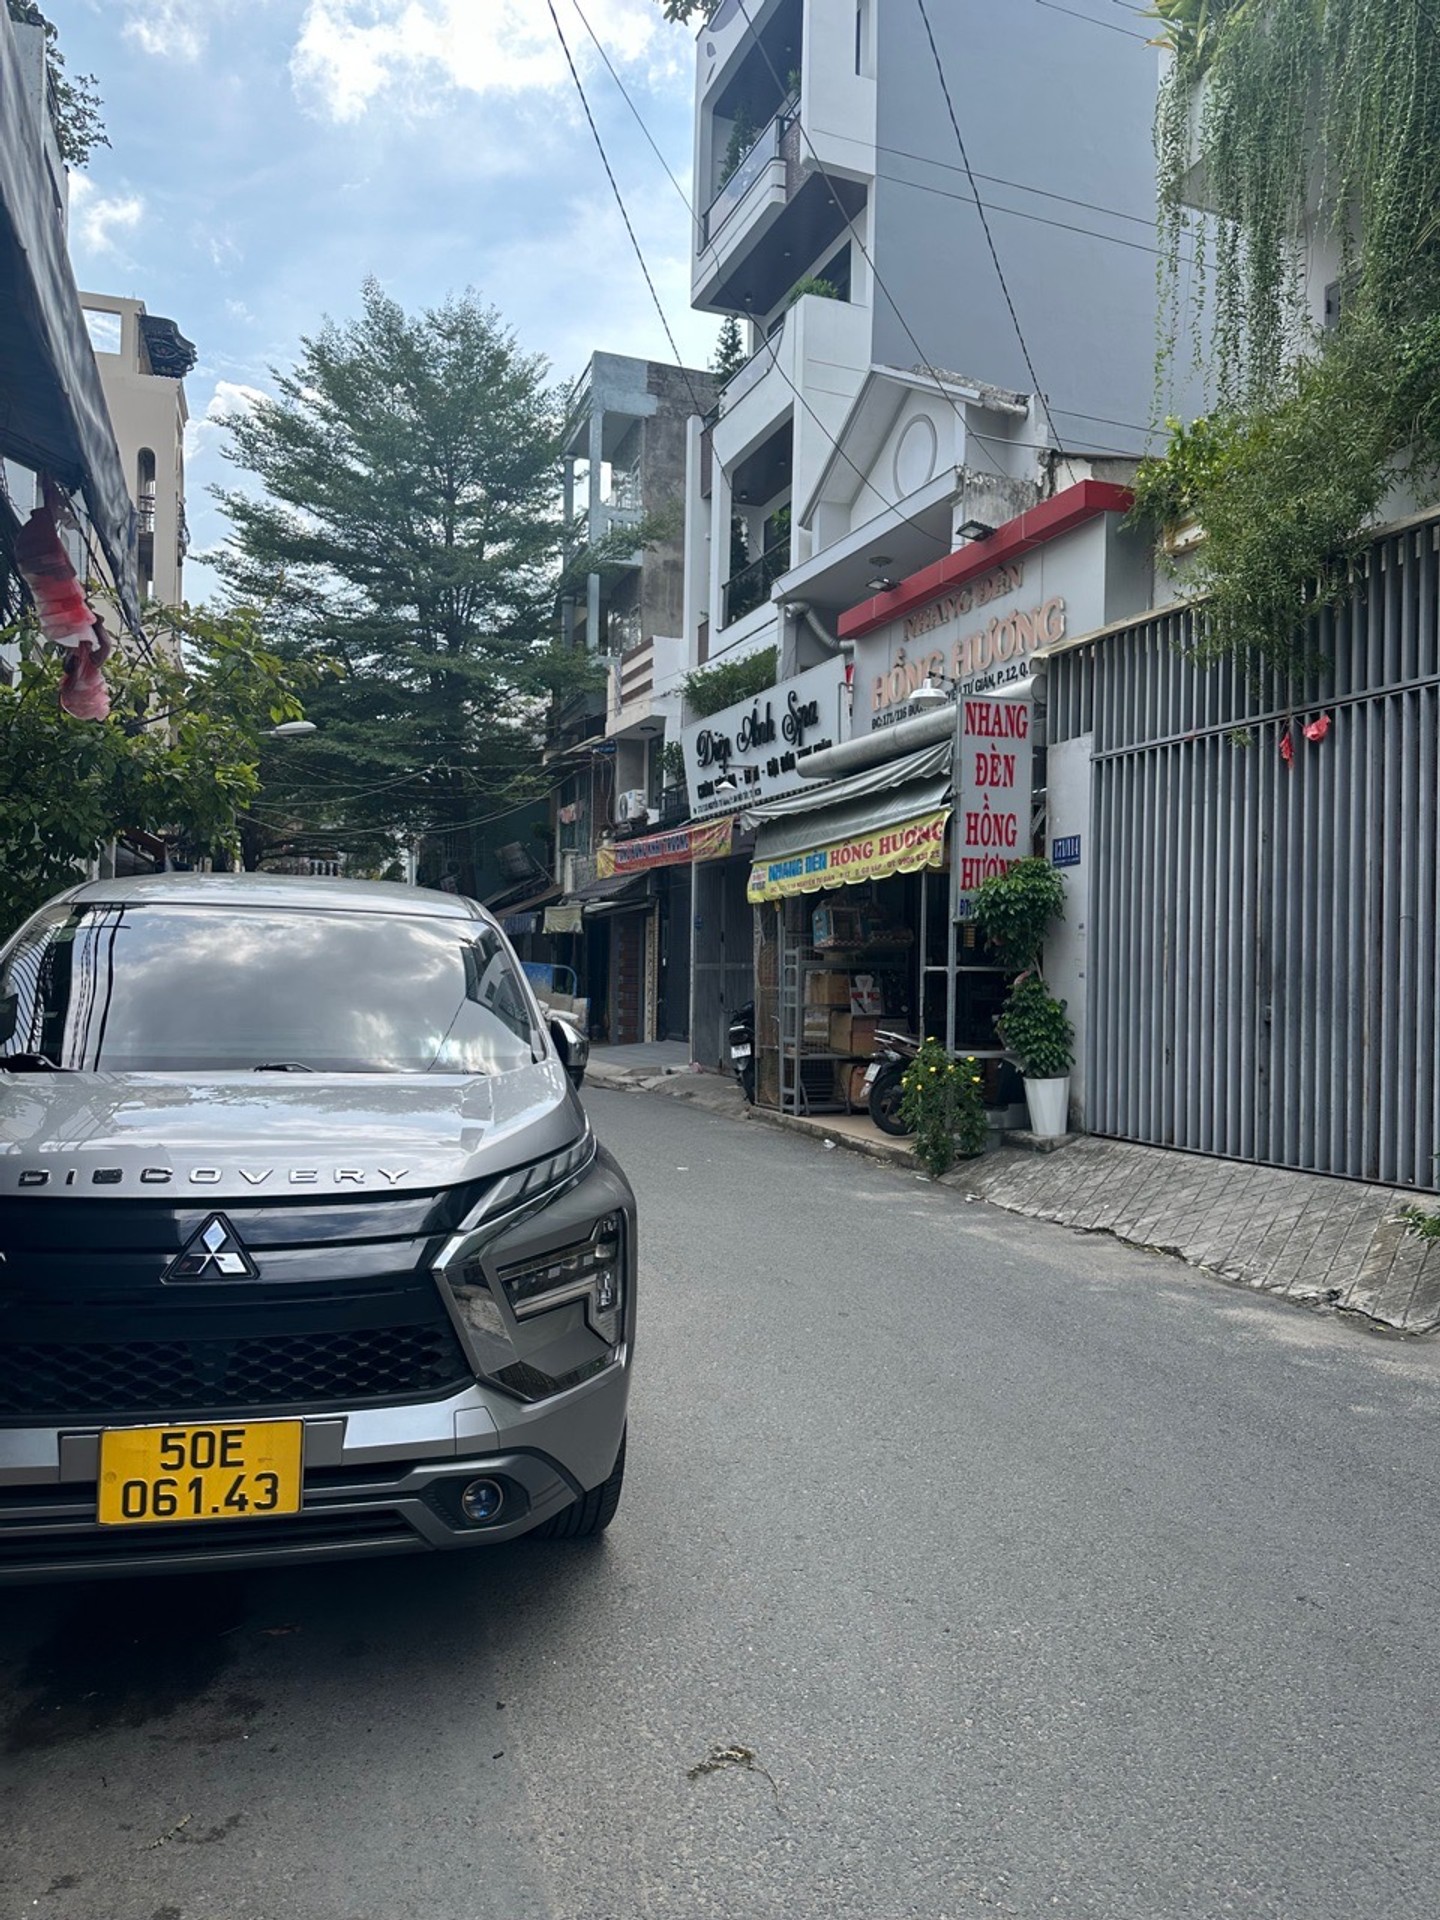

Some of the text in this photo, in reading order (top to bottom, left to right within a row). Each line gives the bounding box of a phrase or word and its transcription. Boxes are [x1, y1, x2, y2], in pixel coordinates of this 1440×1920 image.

[903, 590, 974, 642] NHANG
[871, 596, 1066, 713] HỒNG HƯƠNG
[737, 698, 775, 752] Ánh
[782, 690, 818, 747] Spa
[964, 702, 1029, 740] NHANG
[975, 743, 1015, 788] ĐÈN
[966, 794, 1018, 848] HỒNG
[768, 857, 803, 882] NHANG
[805, 849, 828, 874] ĐÈN
[830, 839, 874, 868] HỒNG
[879, 820, 944, 856] HƯƠNG
[960, 852, 1022, 891] HƯƠN
[18, 1166, 410, 1187] DISCOVERY
[160, 1429, 245, 1471] 50E
[122, 1473, 279, 1519] 061.43
